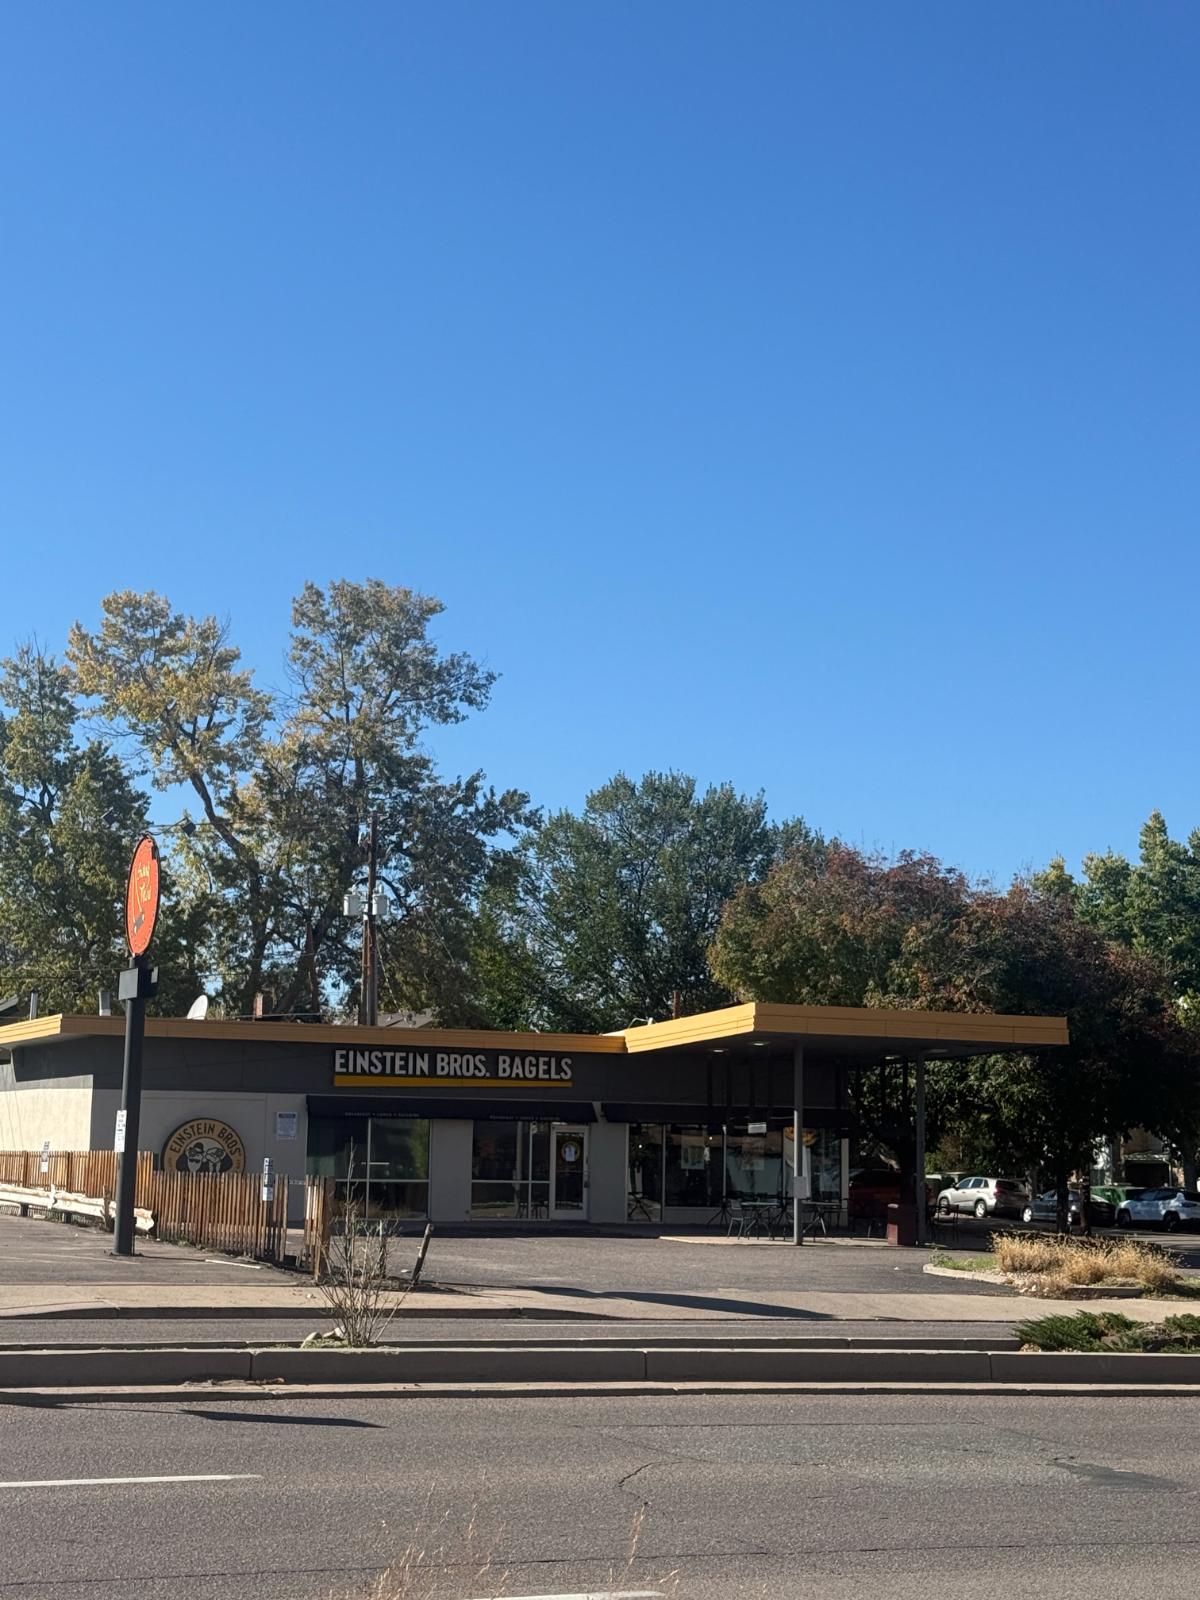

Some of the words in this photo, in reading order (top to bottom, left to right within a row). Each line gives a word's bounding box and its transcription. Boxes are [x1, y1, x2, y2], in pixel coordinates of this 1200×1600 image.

[335, 1050, 429, 1075] EINSTEIN
[437, 1053, 490, 1077] BROS.
[498, 1055, 572, 1079] BAGELS
[170, 1122, 216, 1153] EINSTEIN
